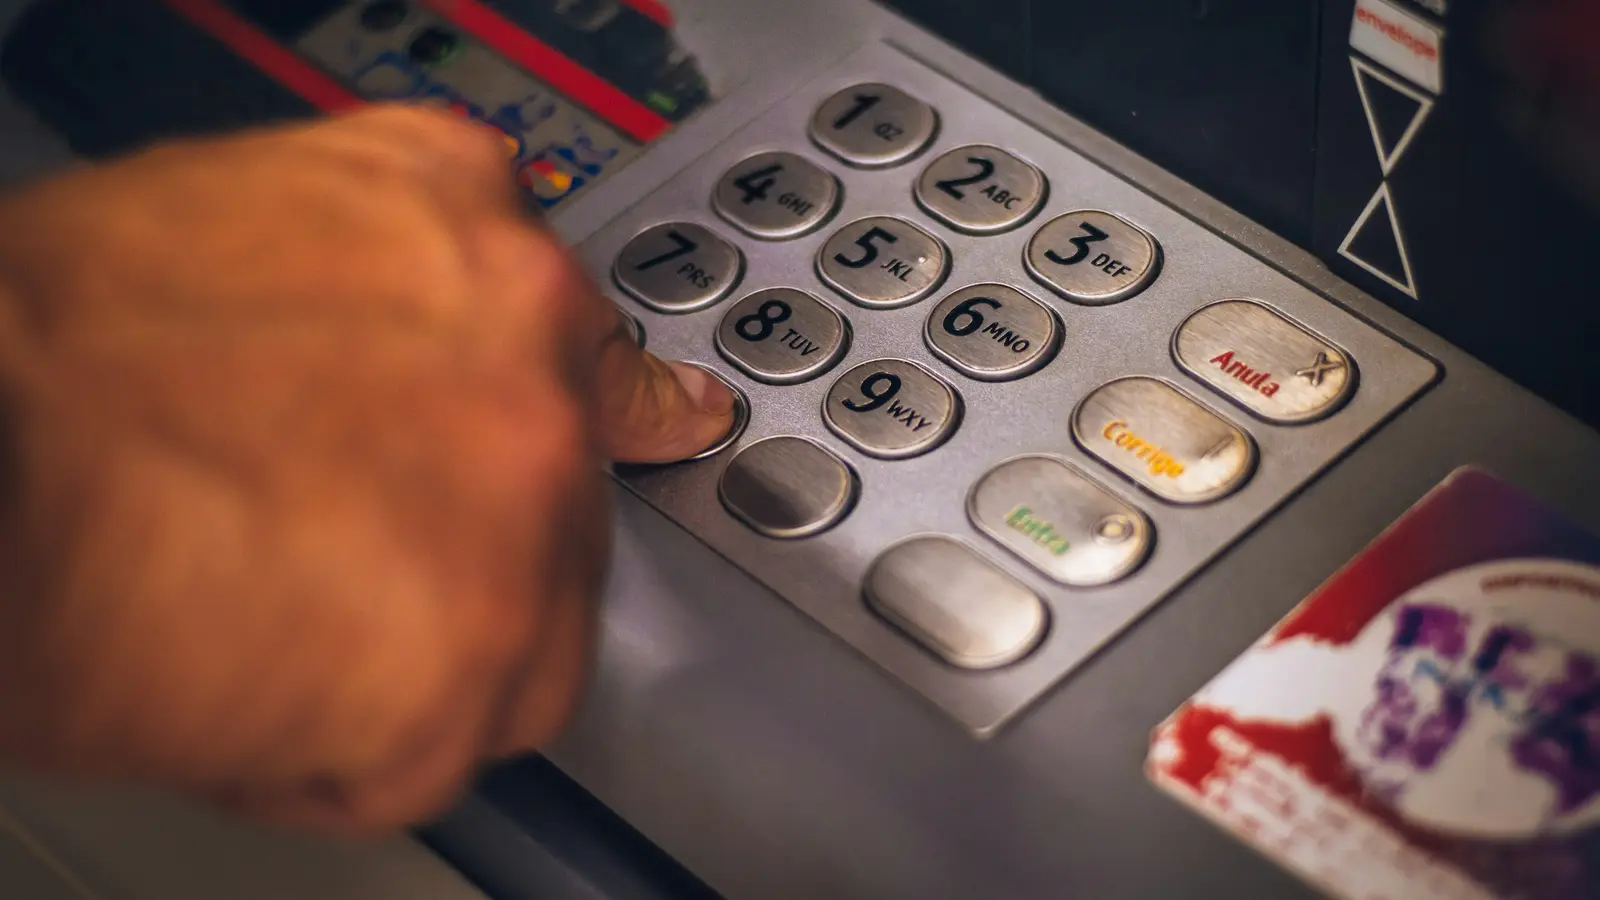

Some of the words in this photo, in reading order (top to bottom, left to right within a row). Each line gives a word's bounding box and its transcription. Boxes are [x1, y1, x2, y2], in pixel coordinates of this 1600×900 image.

[832, 94, 882, 130] 1
[733, 163, 784, 205] 4
[935, 157, 995, 200] 2
[980, 184, 1021, 210] ABC
[634, 229, 698, 271] 7
[677, 262, 716, 290] PRS
[834, 226, 898, 268] 5
[880, 258, 913, 282] JKL
[1044, 221, 1110, 265] 3
[1090, 252, 1132, 279] DEF
[734, 300, 792, 342] 8
[780, 328, 820, 356] TUV
[942, 297, 1003, 337] 6
[982, 321, 1030, 354] MNO
[841, 372, 902, 413] 9
[886, 398, 933, 433] WXY
[1209, 350, 1280, 399] Anula
[1102, 421, 1185, 479] Corrige
